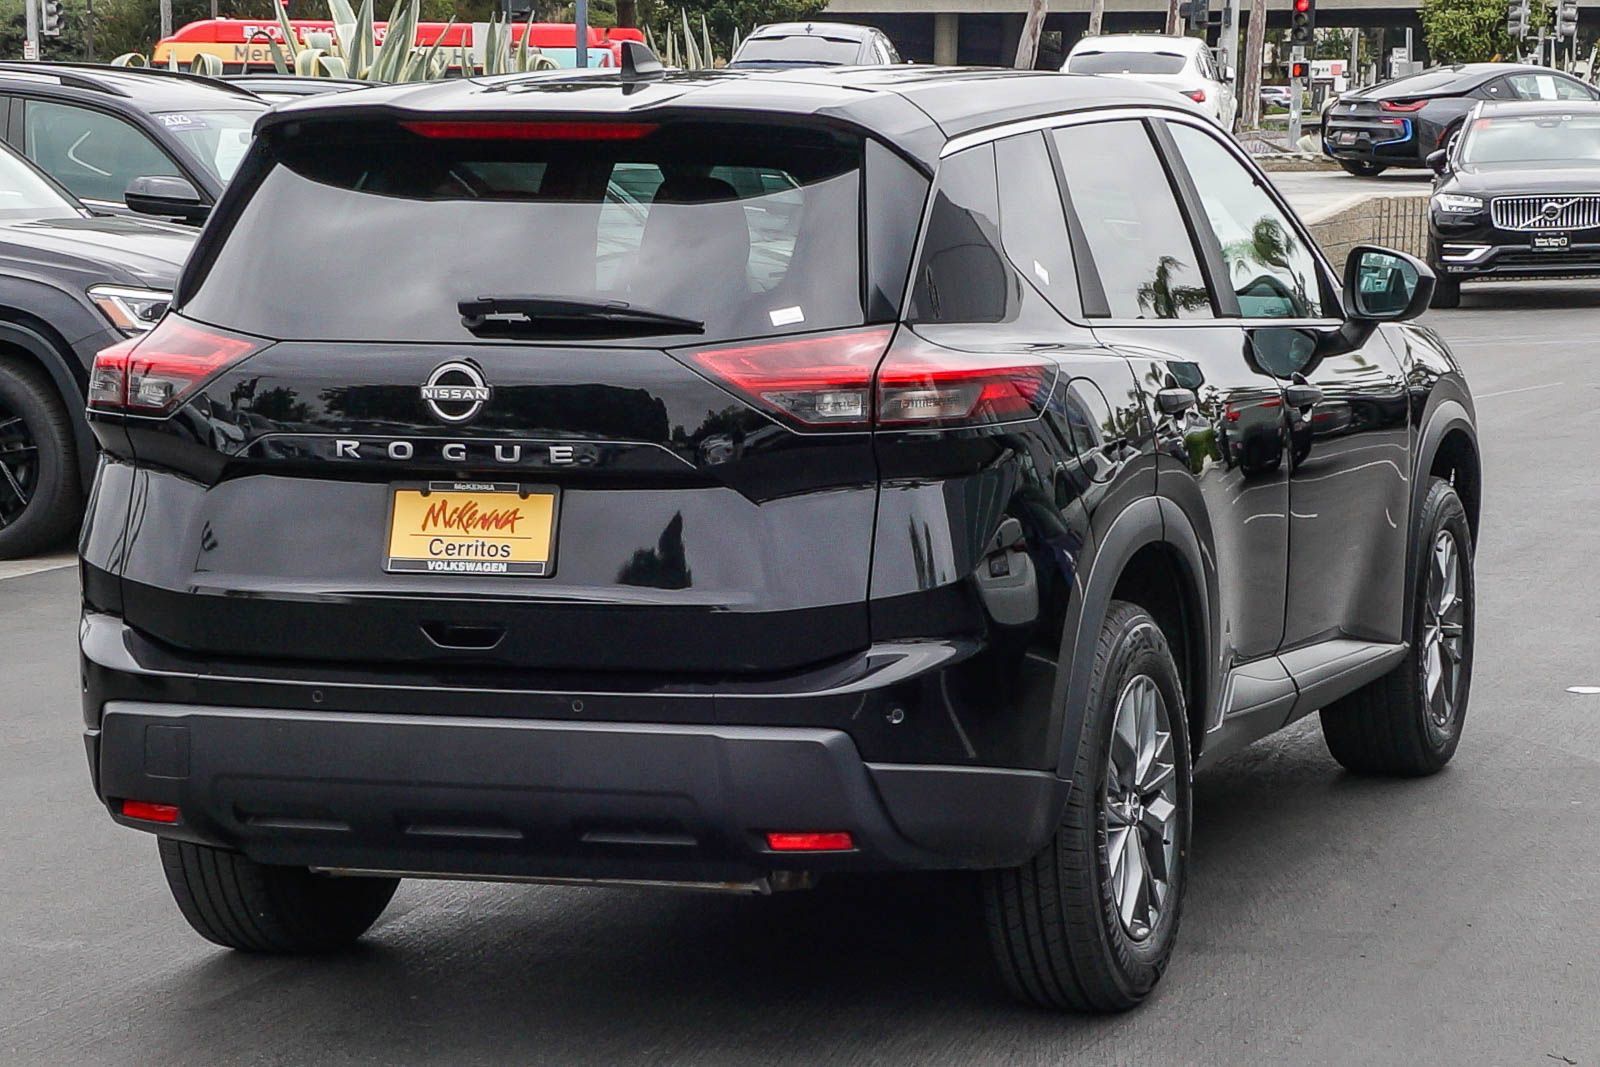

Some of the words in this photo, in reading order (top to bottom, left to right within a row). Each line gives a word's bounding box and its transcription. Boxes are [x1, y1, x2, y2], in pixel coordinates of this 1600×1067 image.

[422, 387, 488, 400] NISSAN
[336, 440, 574, 464] ROGUE
[429, 538, 511, 557] Cerritos
[427, 560, 508, 573] VOLKSWAGEN
